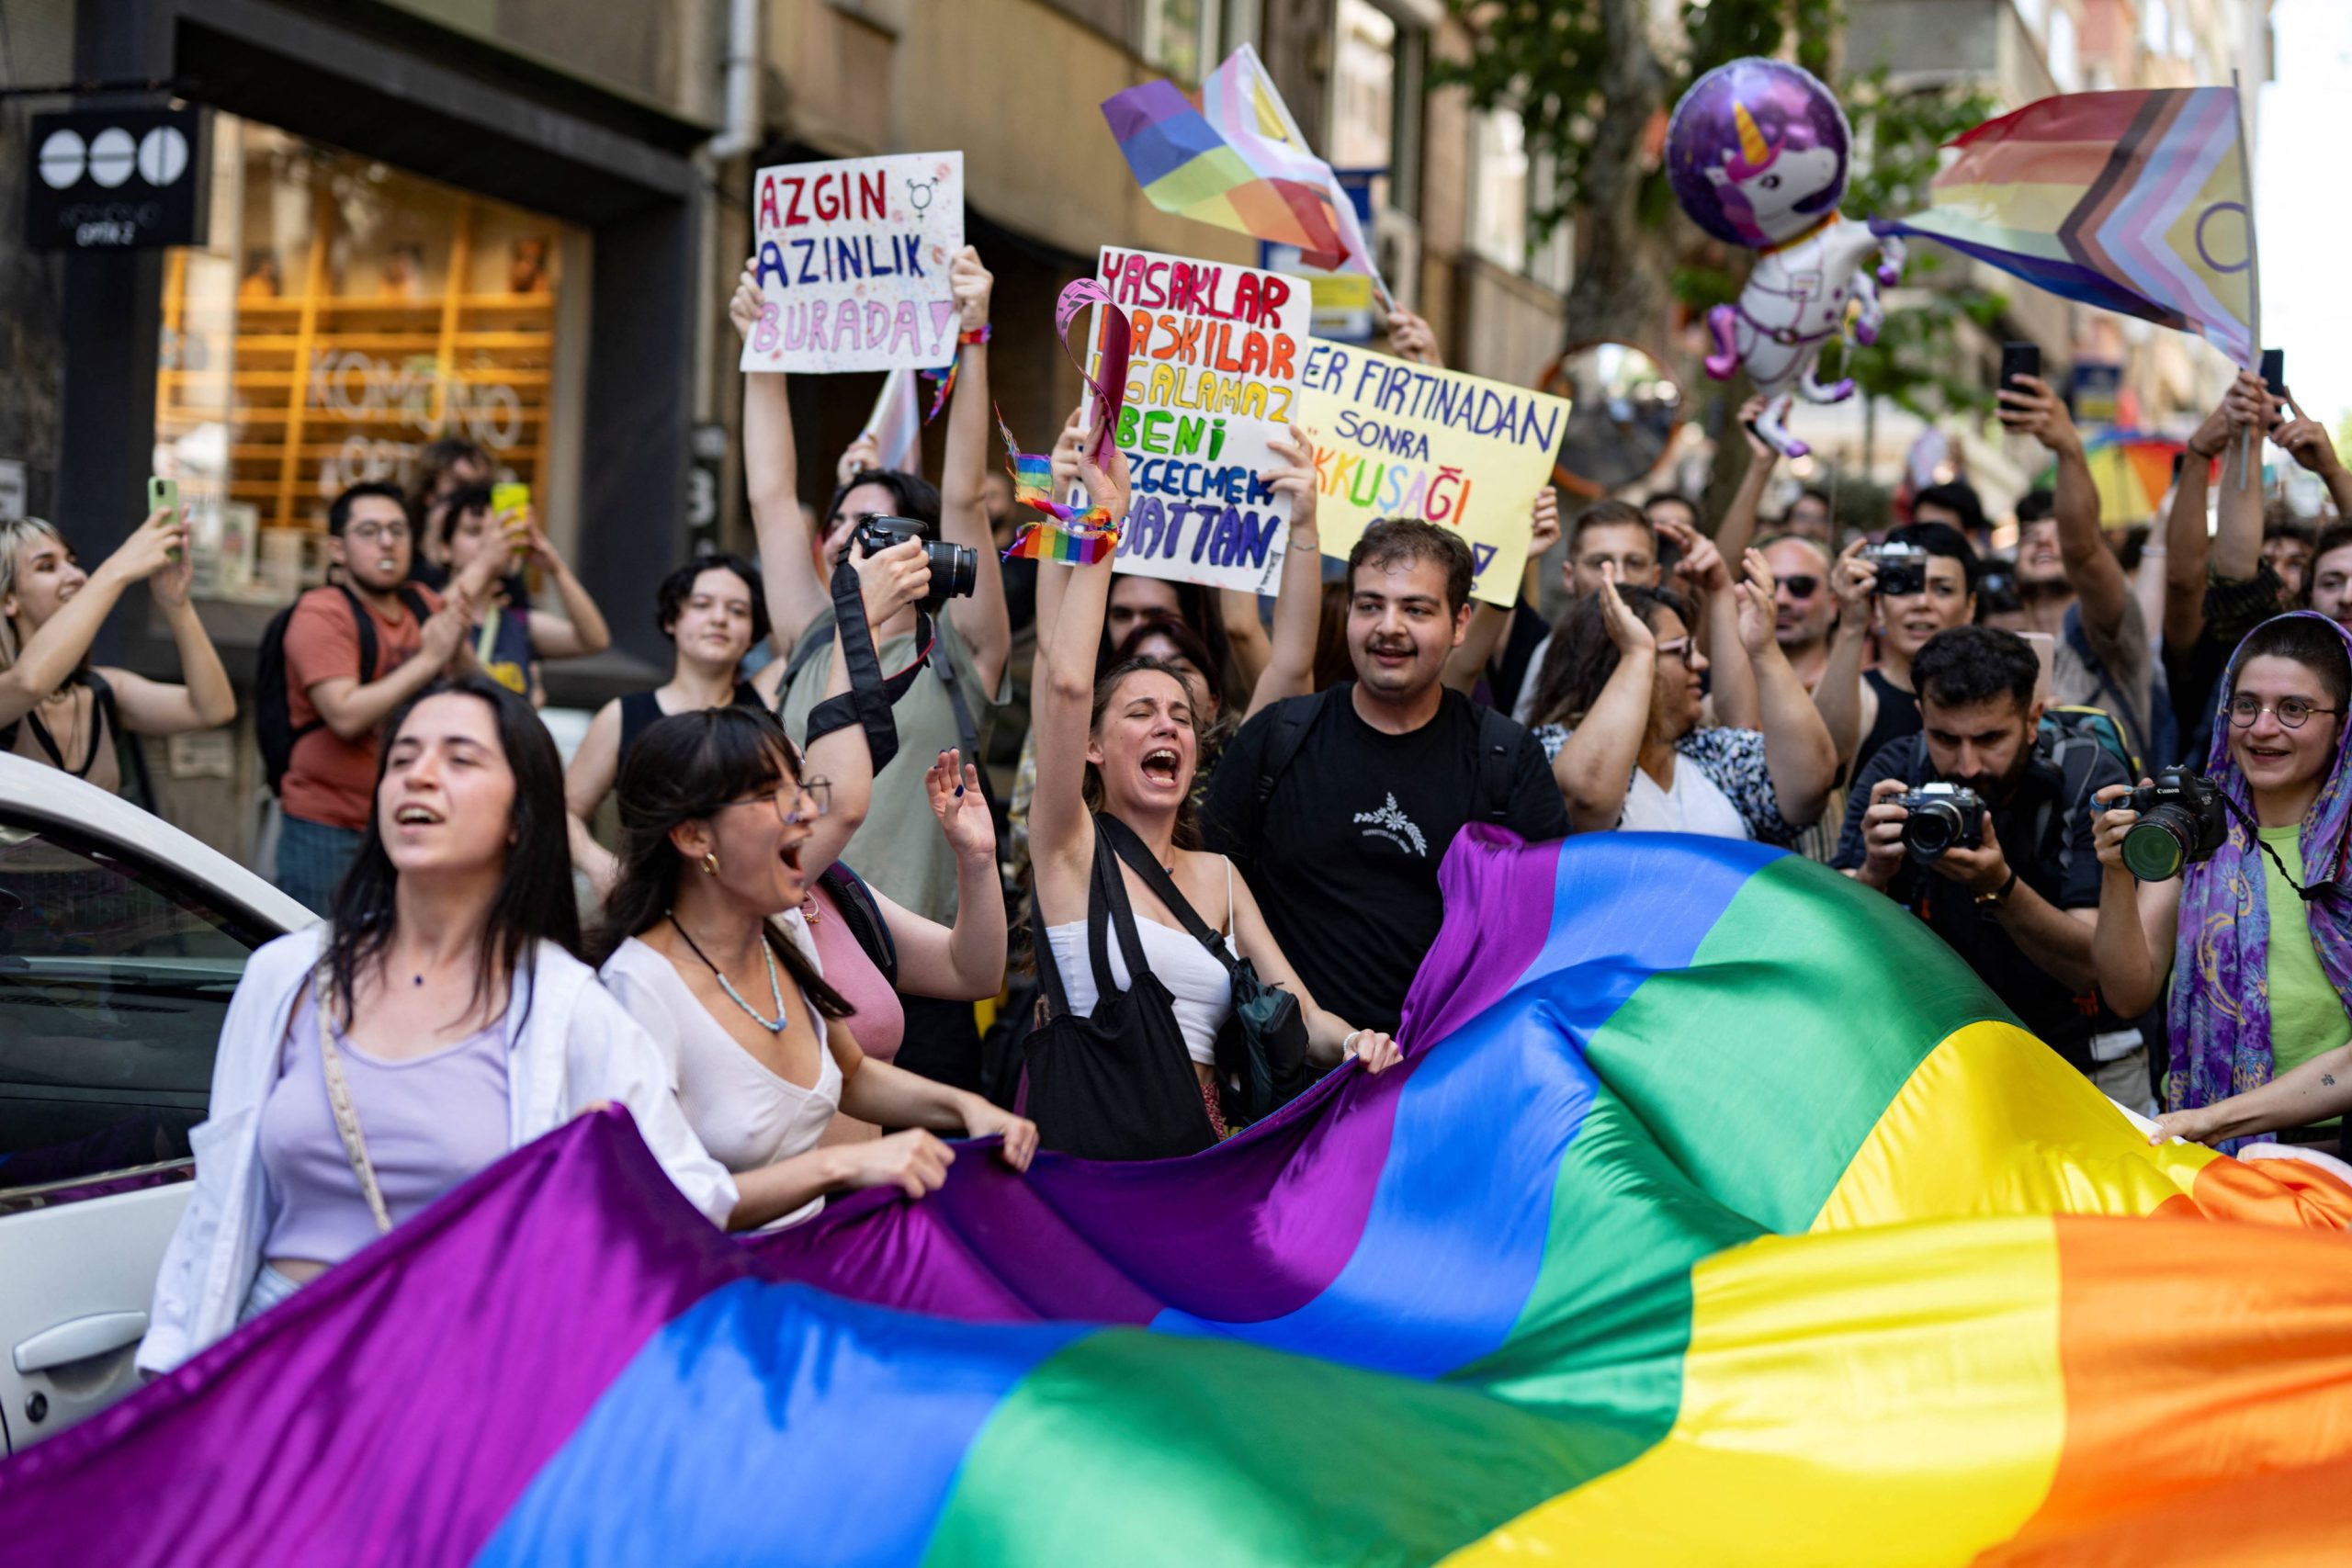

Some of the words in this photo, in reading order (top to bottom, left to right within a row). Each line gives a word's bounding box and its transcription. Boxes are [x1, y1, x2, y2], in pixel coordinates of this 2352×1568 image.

[760, 170, 886, 231] AZGIN
[756, 234, 925, 289] AZINLIK
[1102, 252, 1290, 329] YASAKLAR
[753, 299, 955, 356] BURADA!
[1302, 345, 1350, 395] ER
[1353, 359, 1559, 453] FIRTINADAN
[1335, 410, 1430, 463] SONRA
